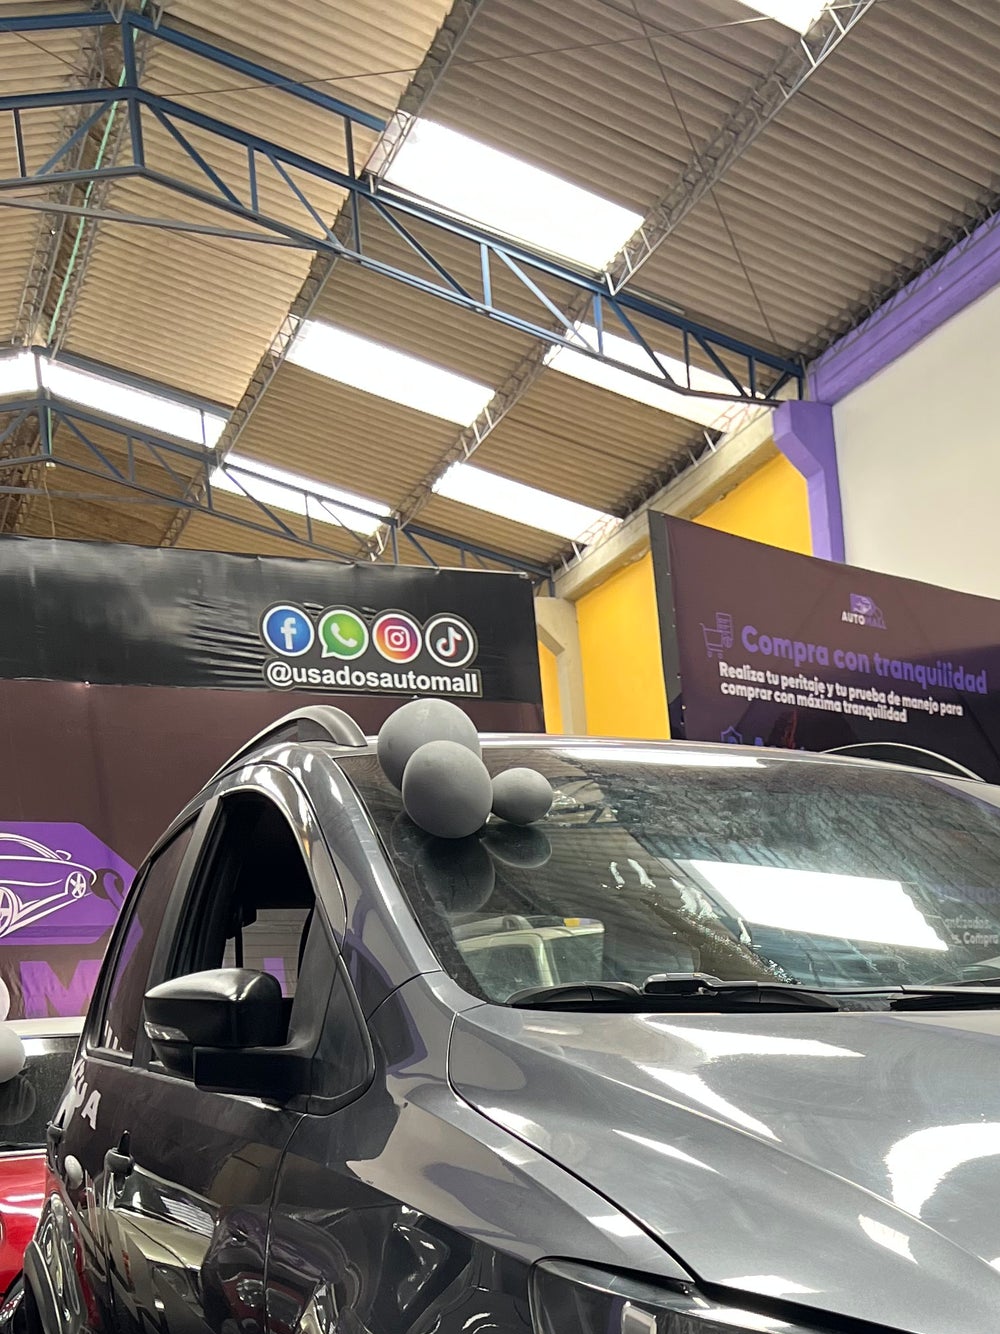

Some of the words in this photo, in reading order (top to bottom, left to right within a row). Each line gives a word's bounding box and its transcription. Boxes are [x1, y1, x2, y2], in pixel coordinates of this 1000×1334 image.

[266, 661, 479, 693] @usadosautomall
[741, 625, 830, 668] Compra
[833, 650, 871, 674] con
[873, 653, 988, 694] tranquilidad
[719, 661, 766, 683] Realiza
[766, 670, 780, 685] tu
[780, 673, 826, 695] peritaje
[826, 682, 834, 698] y
[835, 682, 848, 697] tu
[848, 687, 886, 703] prueba
[887, 690, 901, 706] de
[901, 696, 939, 715] manejo
[940, 702, 964, 716] para
[720, 682, 773, 701] comprar
[773, 690, 796, 705] con
[796, 693, 842, 713] máxima
[842, 700, 908, 723] tranquilidad
